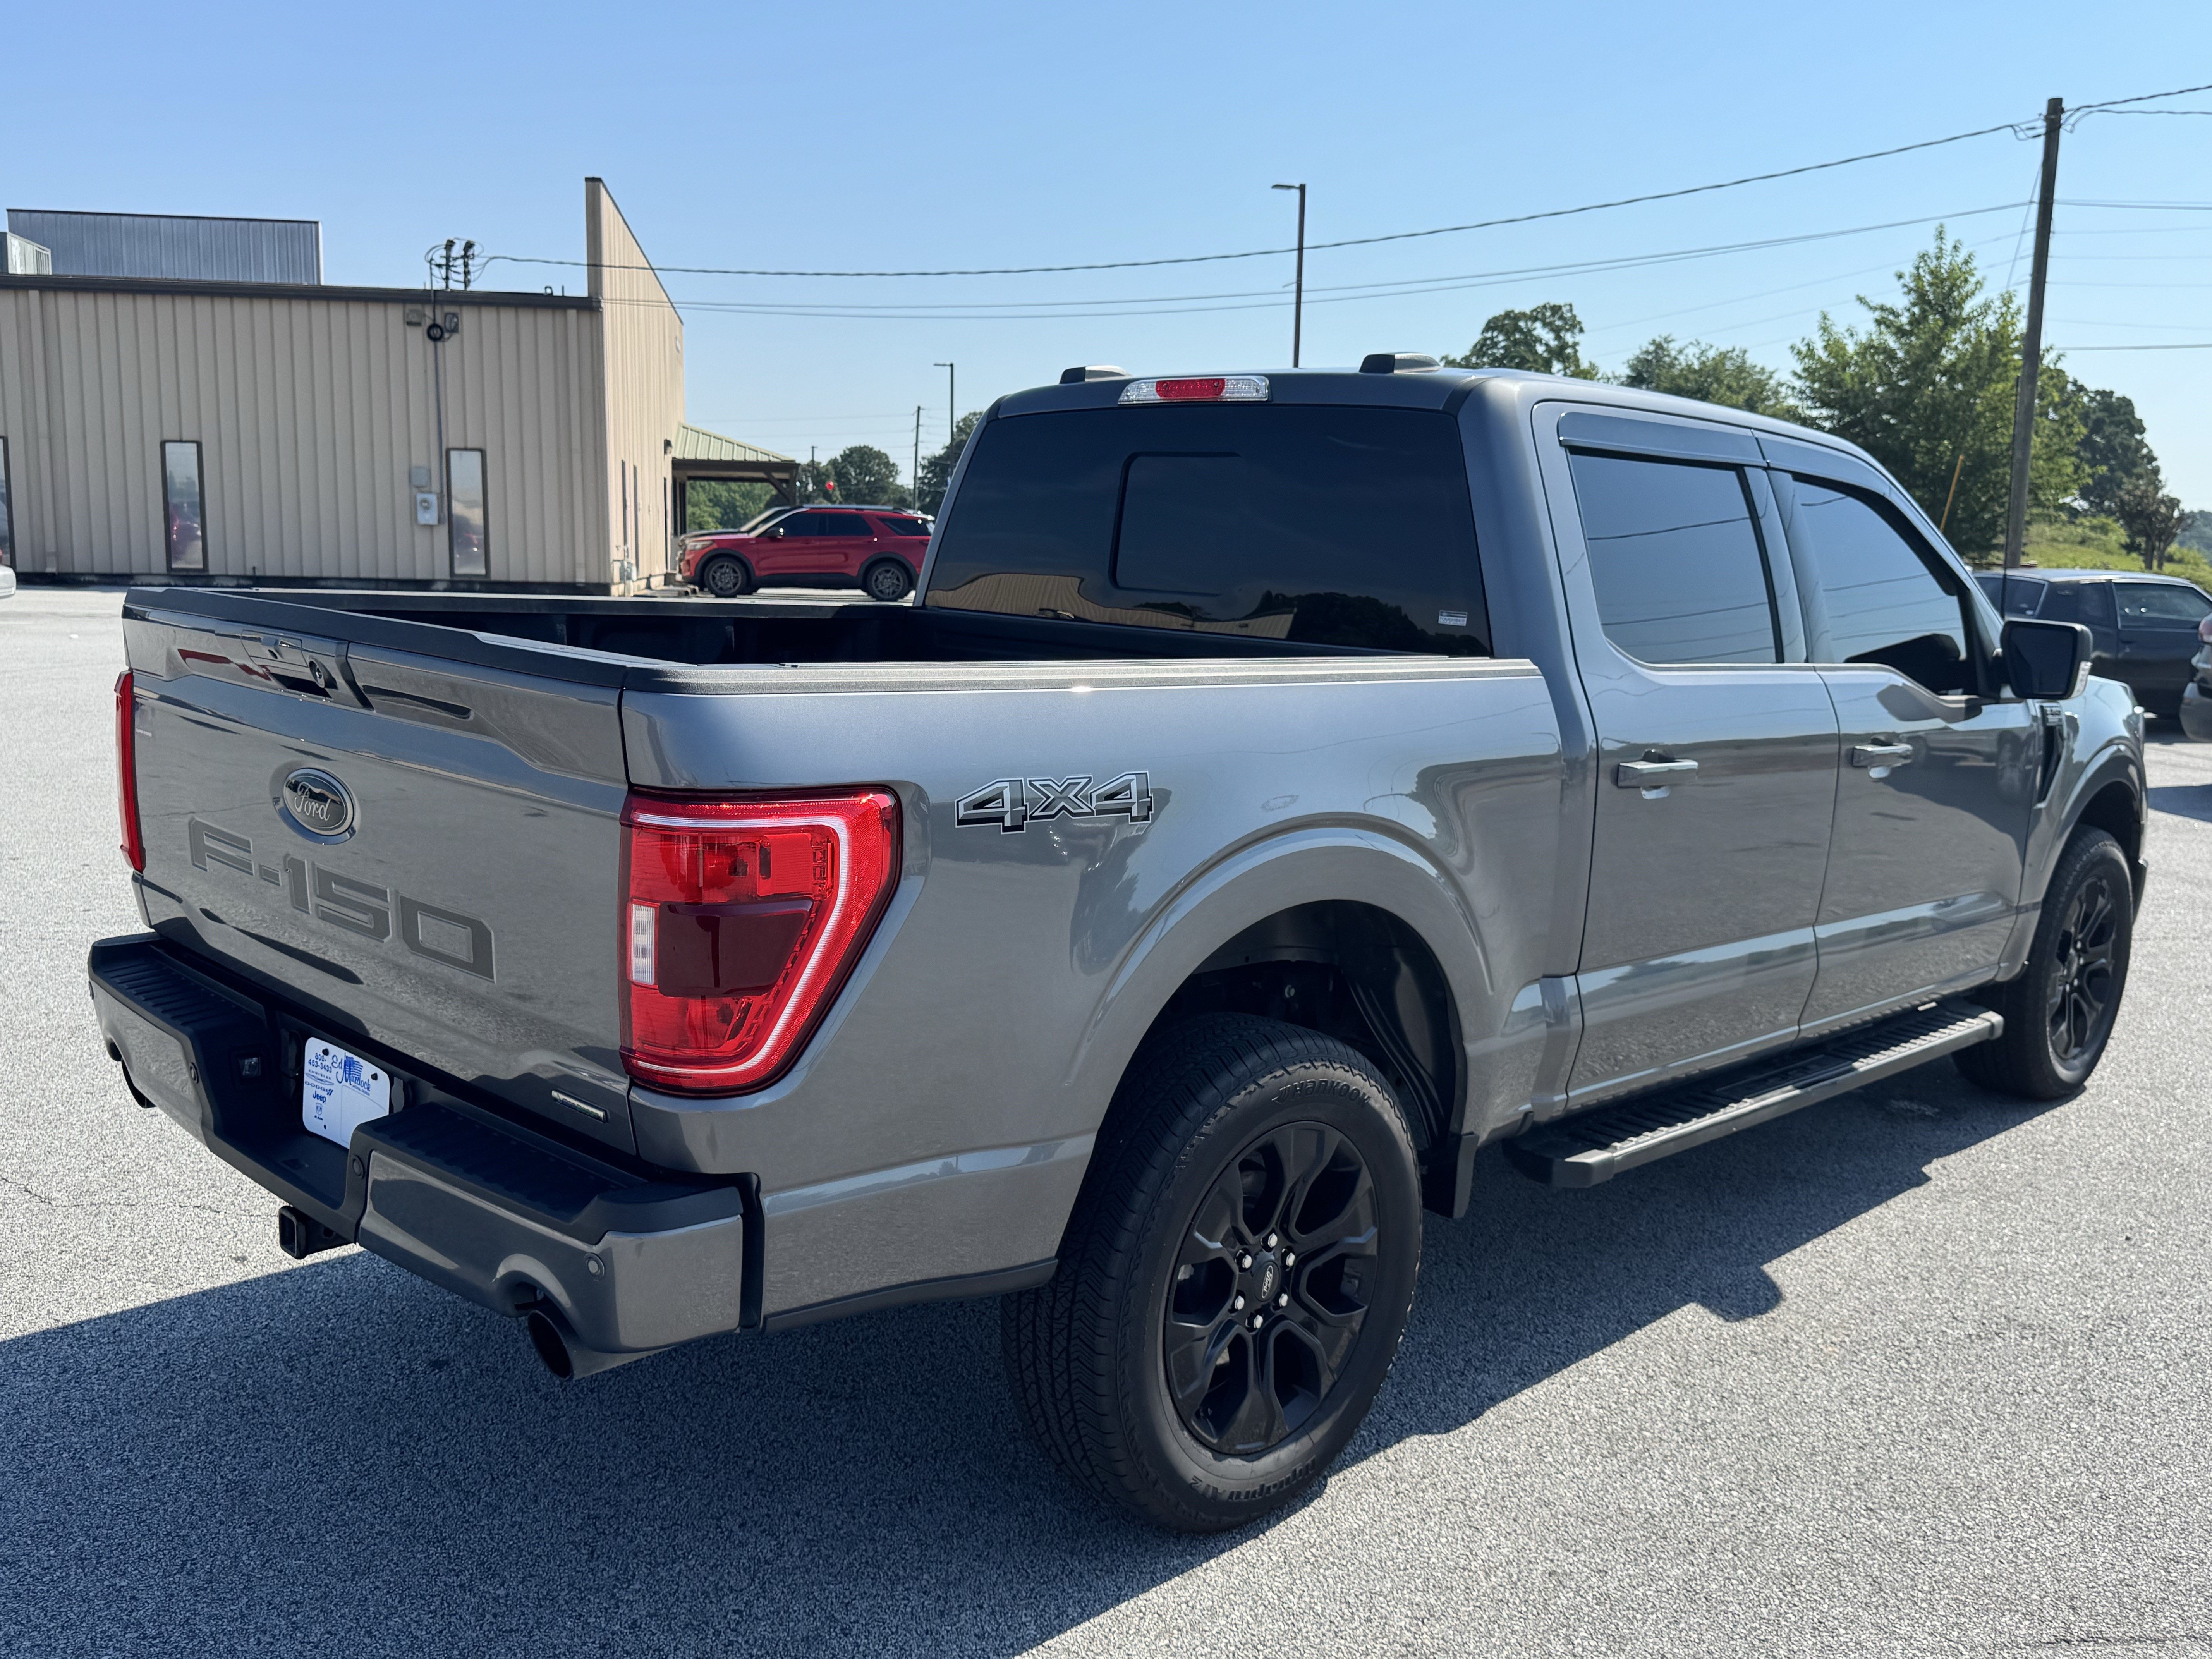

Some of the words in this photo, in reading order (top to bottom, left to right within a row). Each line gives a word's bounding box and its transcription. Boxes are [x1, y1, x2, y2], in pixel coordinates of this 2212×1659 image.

[294, 781, 332, 821] Ford
[189, 817, 496, 983] F-150
[331, 1054, 343, 1070] Ed
[313, 1091, 326, 1103] Jeep
